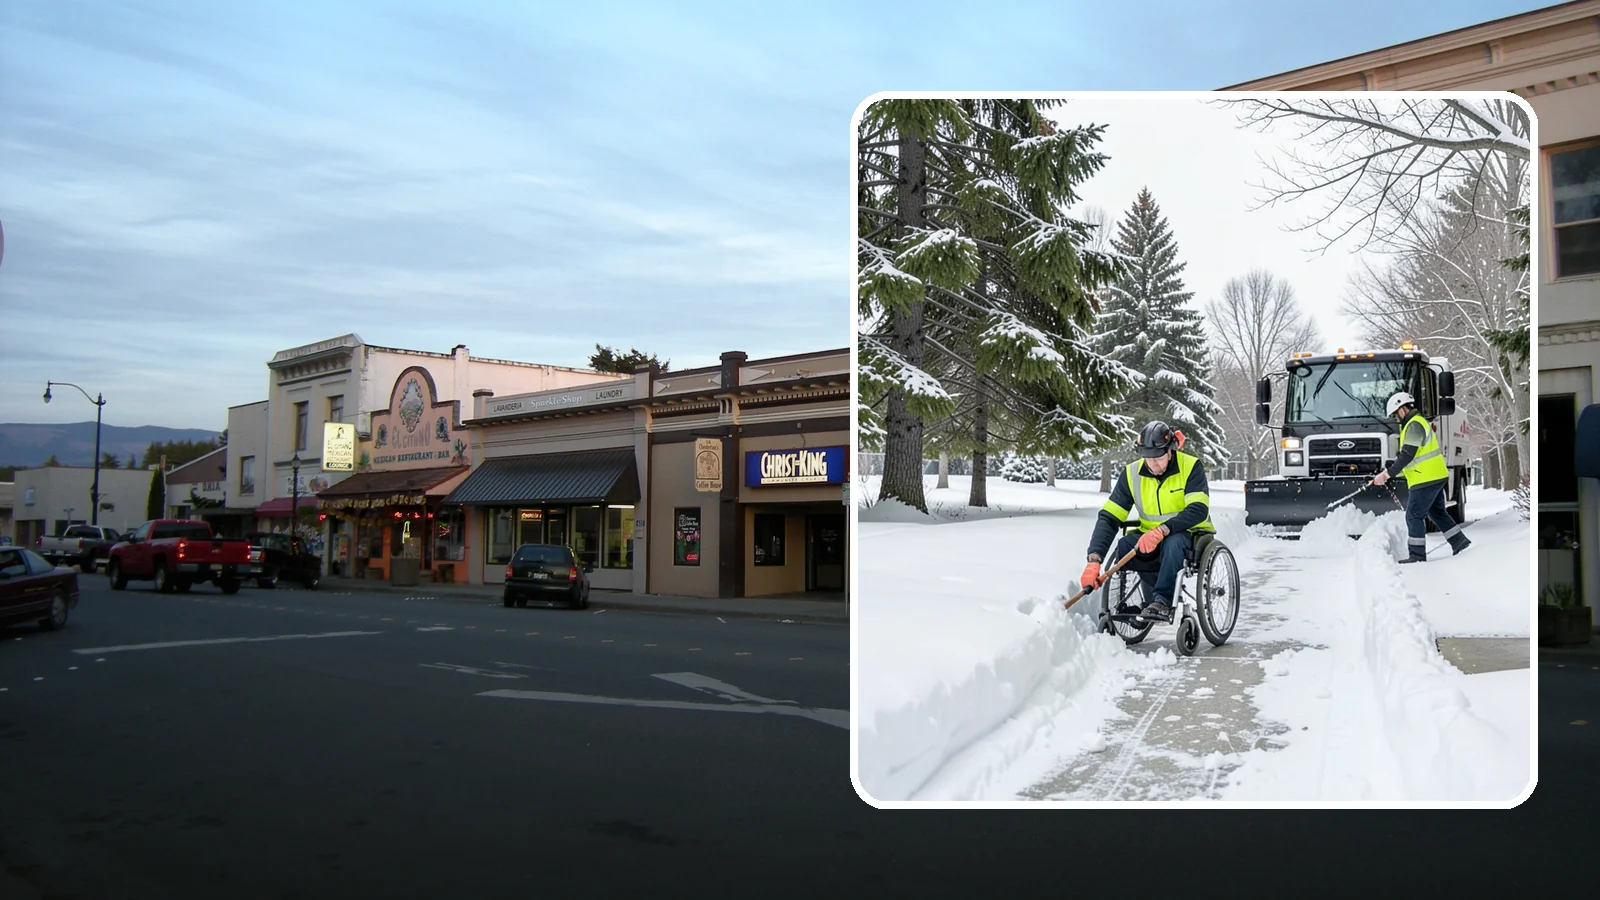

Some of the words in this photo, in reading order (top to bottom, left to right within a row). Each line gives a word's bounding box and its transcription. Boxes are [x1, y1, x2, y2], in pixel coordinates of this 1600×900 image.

[562, 394, 583, 404] Shop
[595, 389, 623, 399] LAUNDRY
[493, 402, 522, 412] LAVANDERIA
[373, 454, 396, 464] MEXICAN
[397, 451, 434, 462] RESTAURANT
[438, 450, 450, 459] BAR
[760, 452, 797, 478] CHRIST
[799, 450, 827, 476] KING
